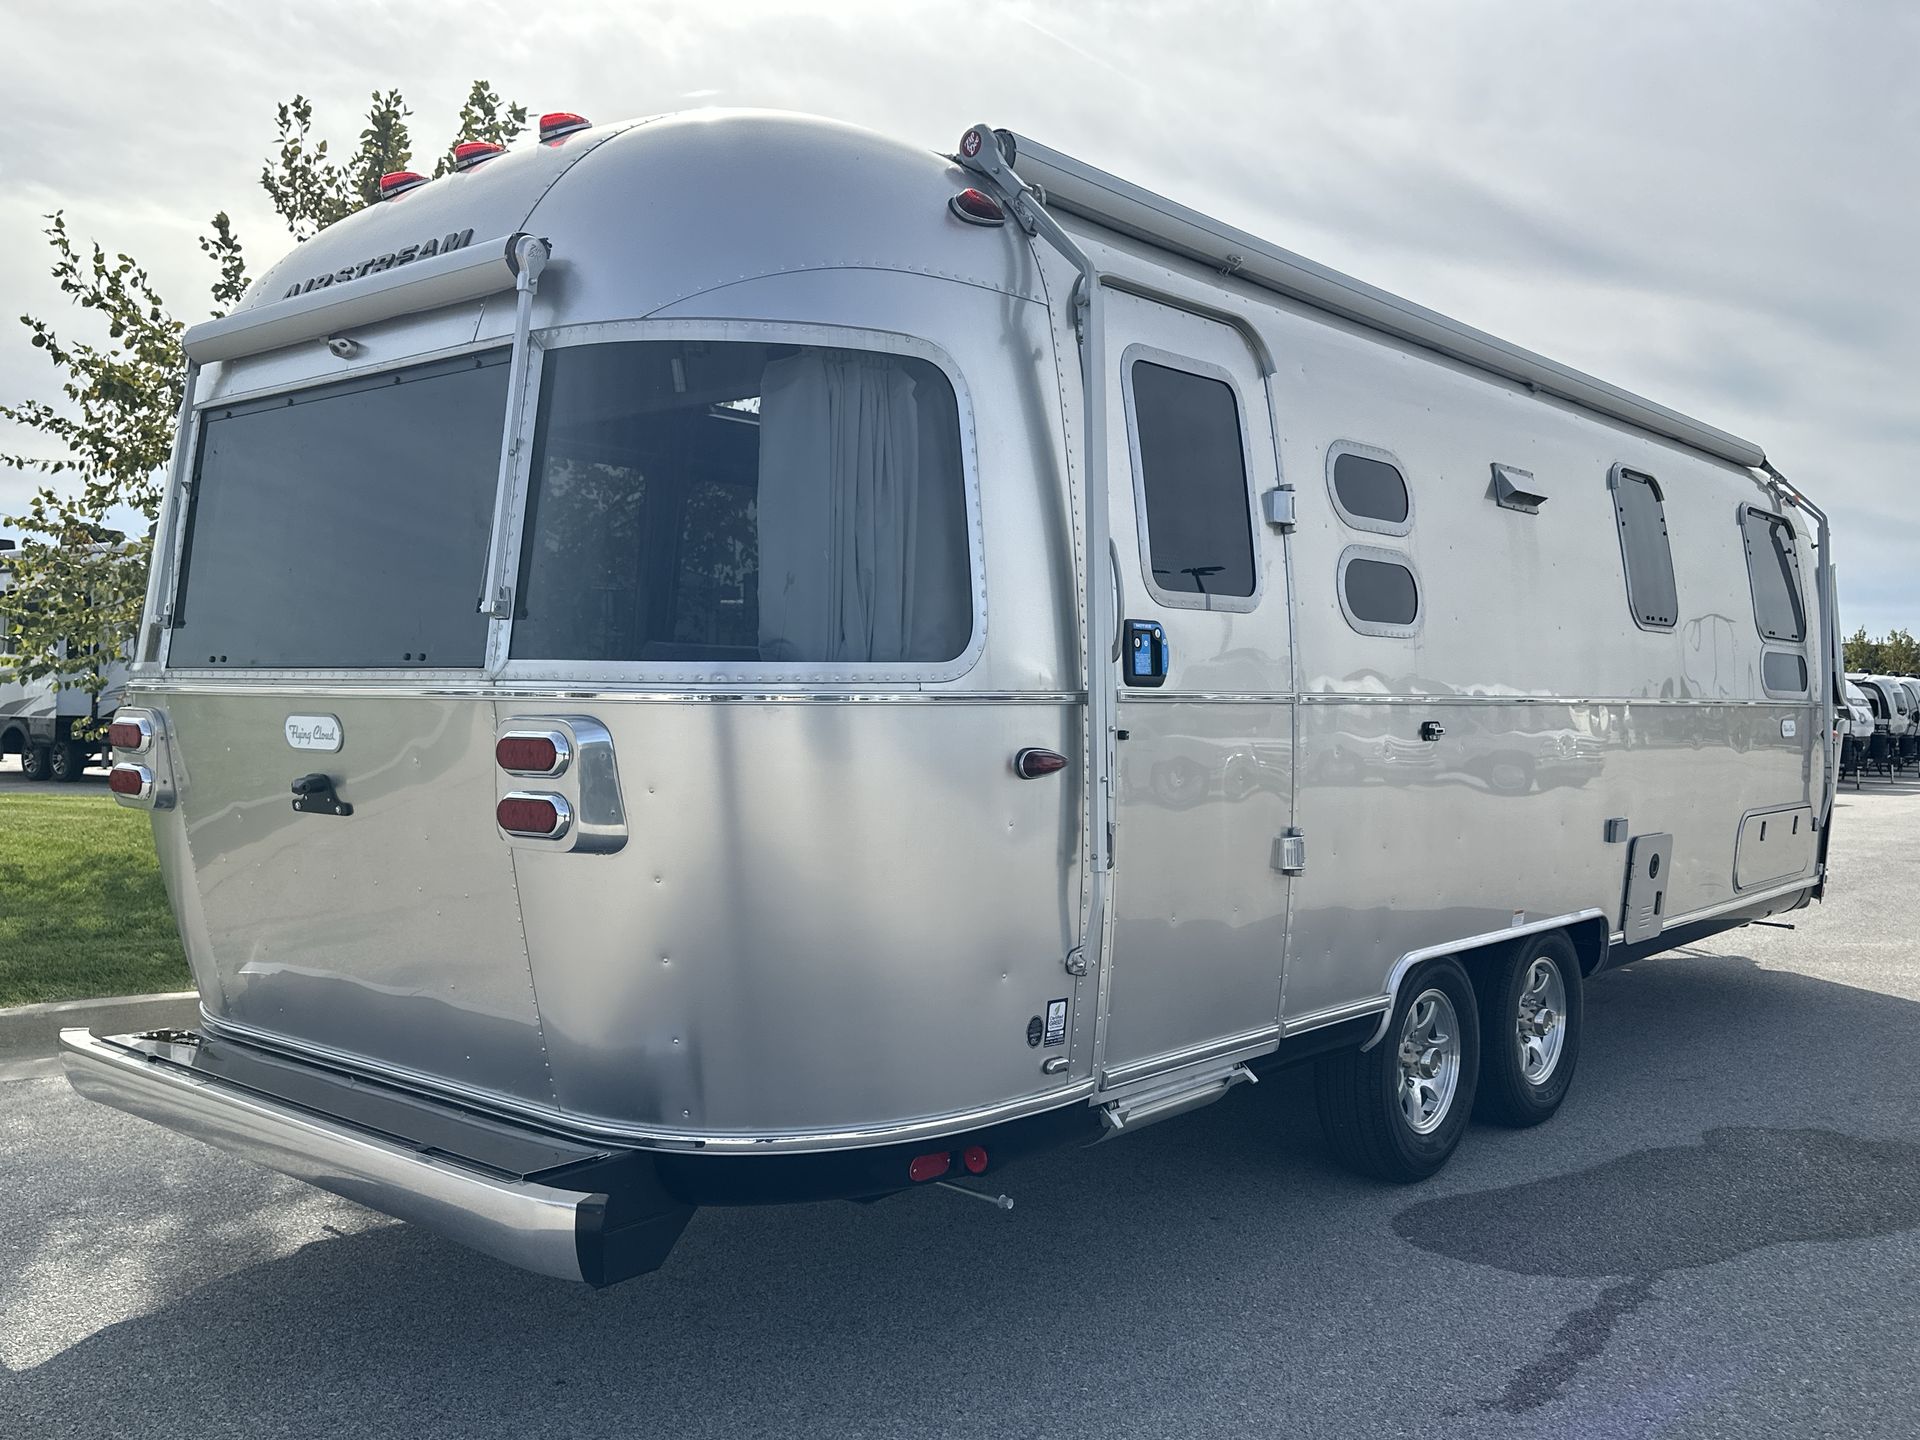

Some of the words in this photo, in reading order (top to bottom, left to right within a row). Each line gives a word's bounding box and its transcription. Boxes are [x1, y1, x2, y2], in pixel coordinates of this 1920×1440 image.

[282, 228, 474, 300] AIRSTREAM
[289, 724, 312, 745] Flying
[313, 724, 336, 741] Cloud
